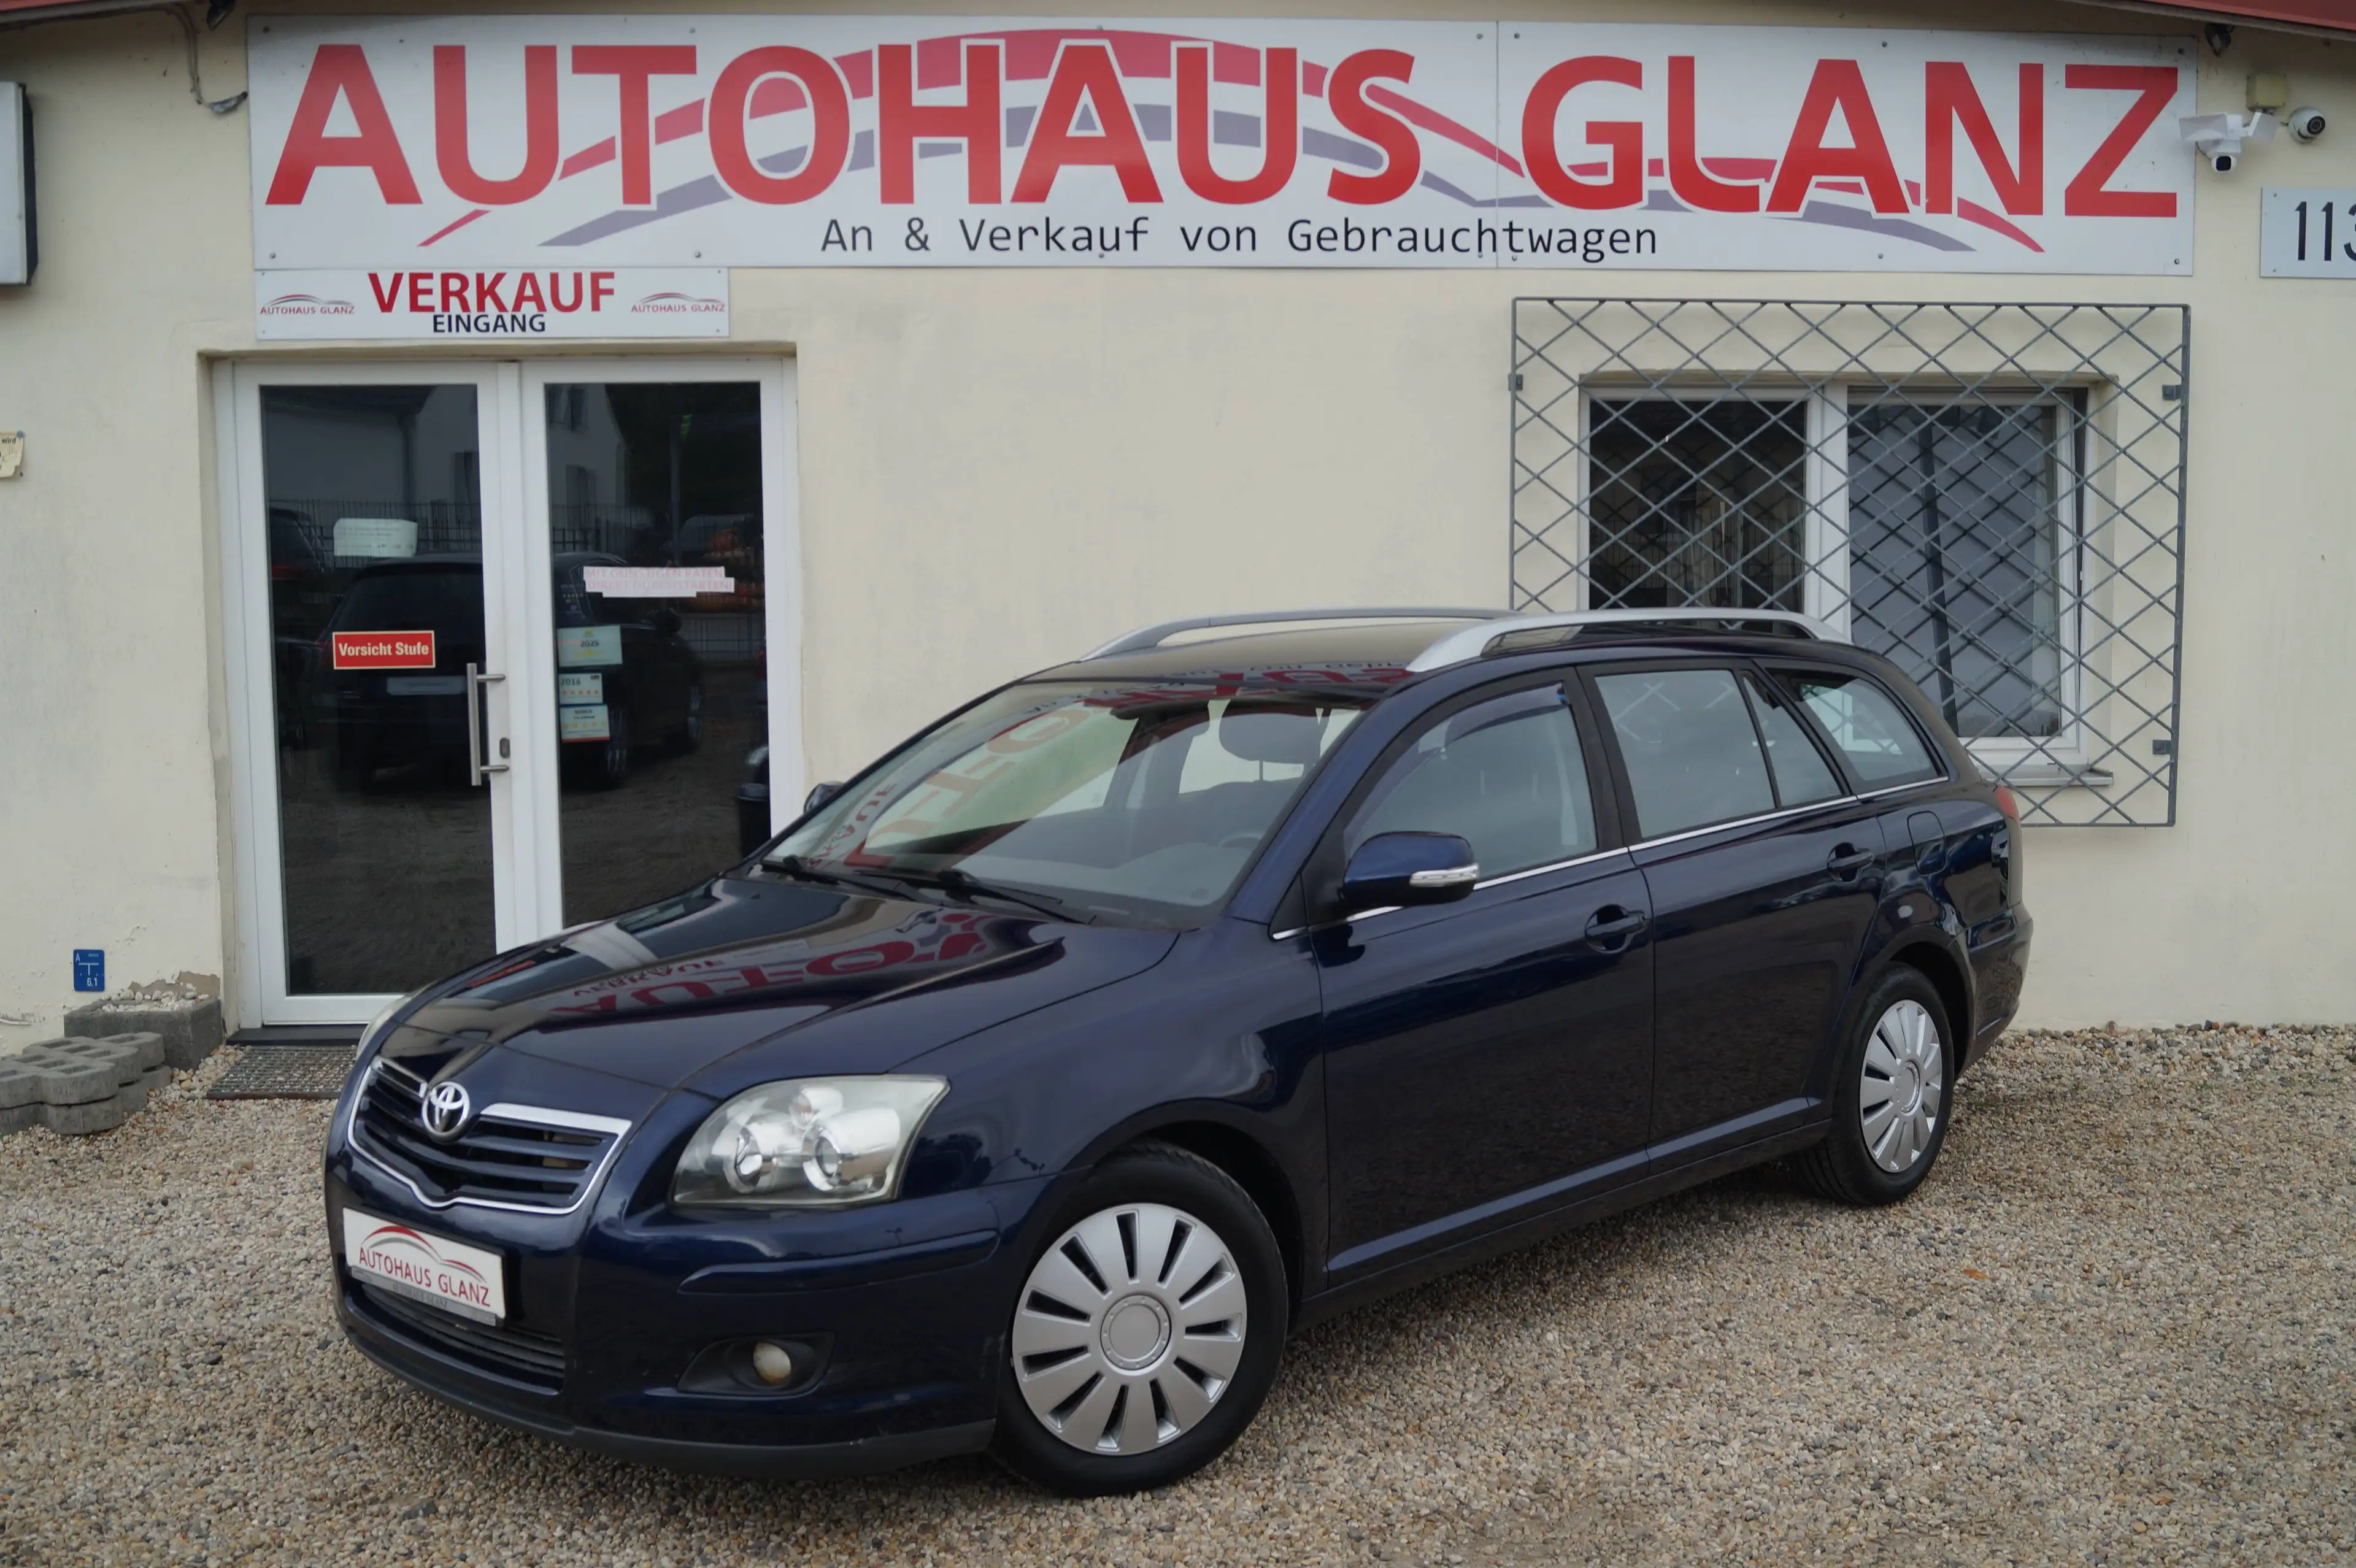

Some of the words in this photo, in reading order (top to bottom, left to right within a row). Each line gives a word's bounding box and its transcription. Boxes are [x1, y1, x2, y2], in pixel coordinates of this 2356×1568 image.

[265, 44, 1421, 206] AUTOHAUS
[1522, 55, 2179, 217] GLANZ
[820, 218, 872, 252] An
[904, 217, 931, 252] &
[959, 217, 1149, 252] Verkauf
[1180, 225, 1257, 252] von
[1288, 217, 1658, 263] Gebrauchtwagen
[368, 272, 615, 313] VERKAUF
[260, 306, 316, 315] AUTOHAUS
[320, 306, 355, 315] GLANZ
[631, 304, 687, 313] AUTOHAUS
[690, 303, 725, 312] GLANZ
[433, 314, 546, 334] EINGANG
[585, 568, 607, 578] MIT
[337, 642, 393, 657] Vorsicht
[395, 641, 429, 656] Stufe
[75, 952, 81, 962] A
[87, 977, 98, 987] 6.1
[359, 1247, 432, 1288] AUTOHAUS
[437, 1274, 491, 1307] GLANZ
